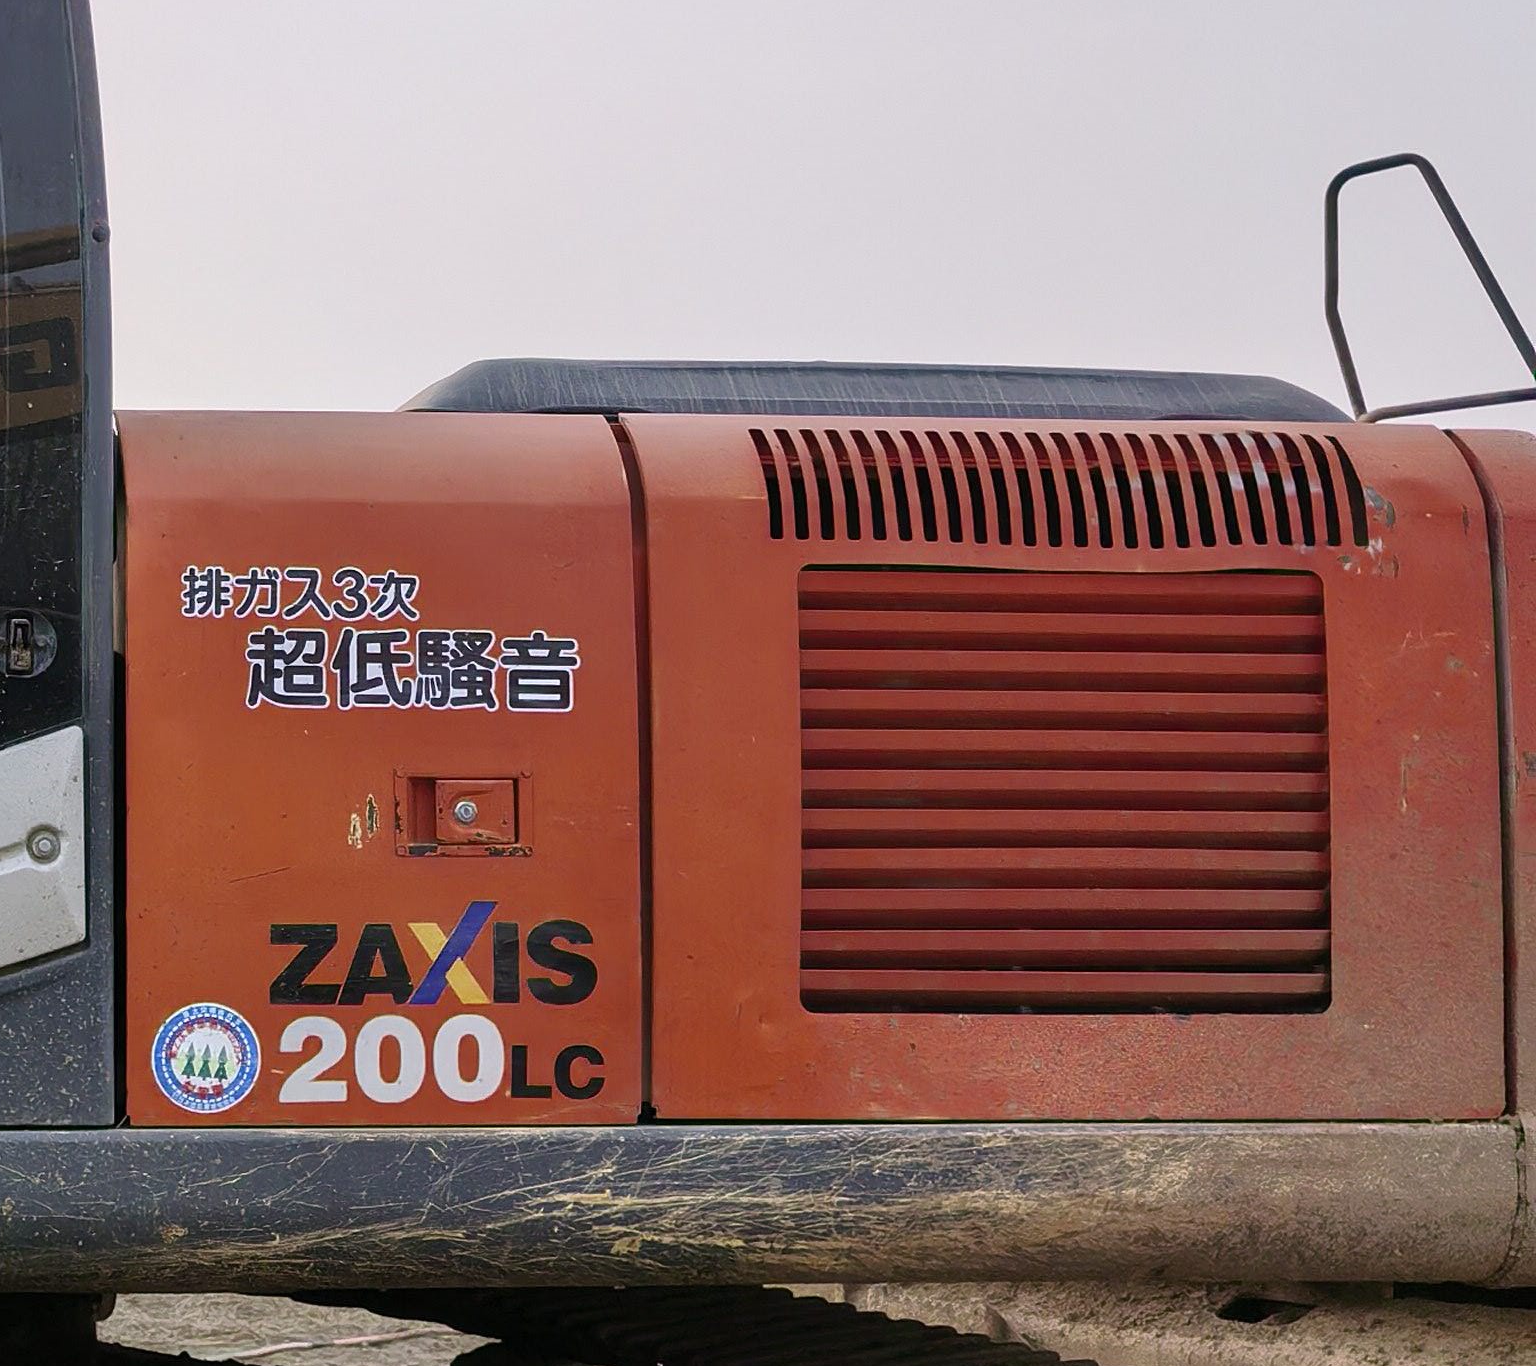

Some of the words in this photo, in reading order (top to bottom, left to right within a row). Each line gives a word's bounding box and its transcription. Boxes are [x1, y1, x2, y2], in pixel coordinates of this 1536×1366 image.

[181, 566, 420, 621] 排ガス3次
[245, 626, 581, 713] 超低騒音
[269, 900, 599, 1006] ZAXIS
